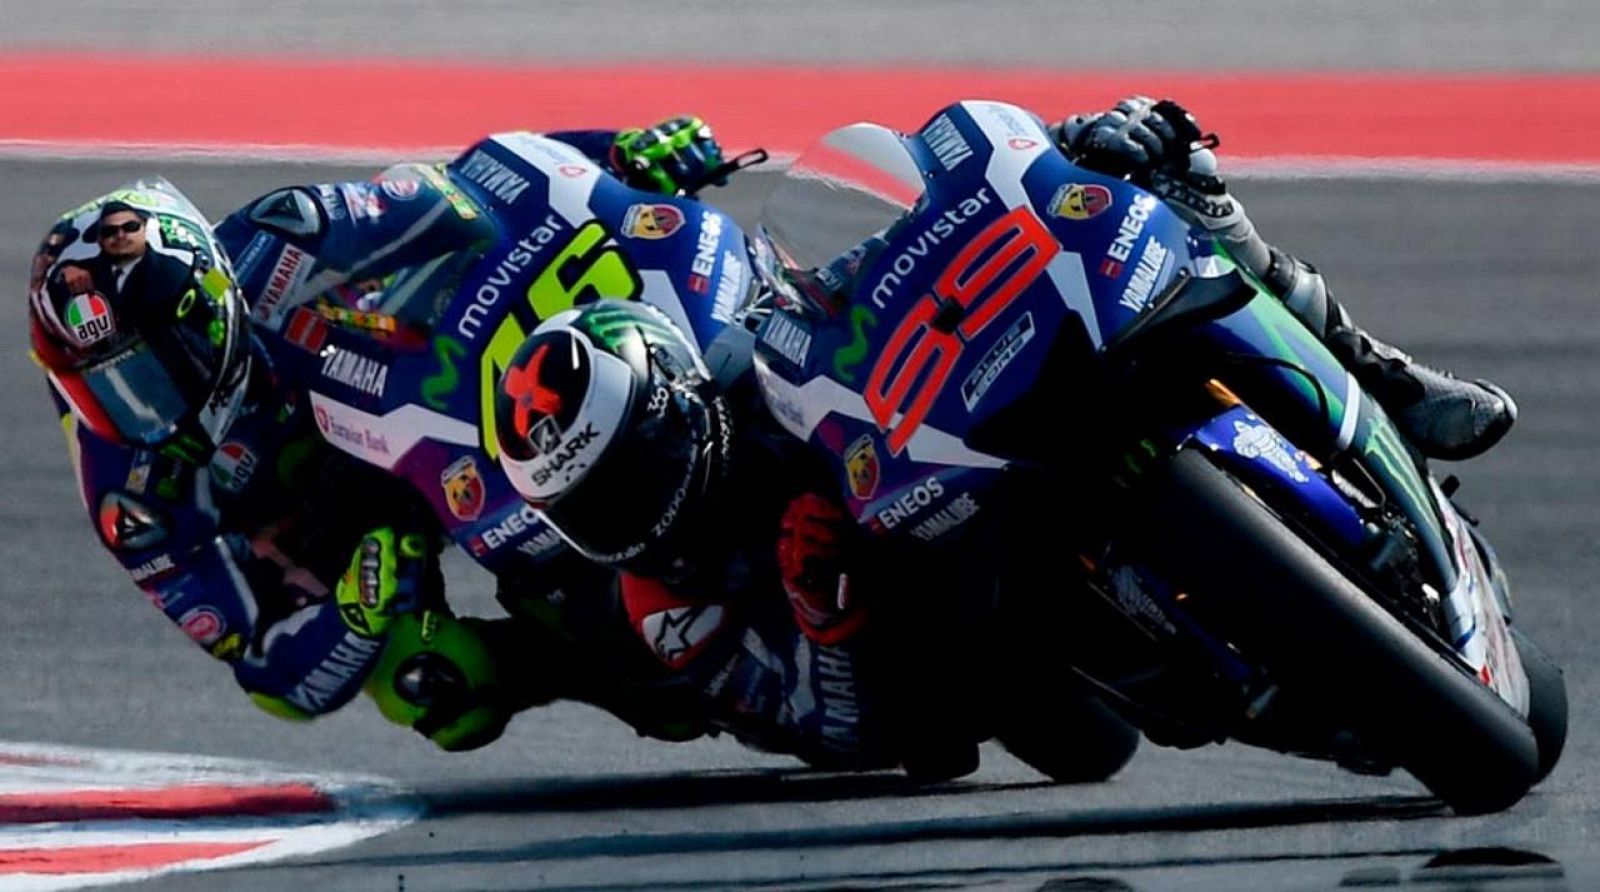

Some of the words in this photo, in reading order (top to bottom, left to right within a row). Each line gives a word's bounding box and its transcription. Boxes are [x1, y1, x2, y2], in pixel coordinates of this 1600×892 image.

[460, 150, 530, 205] YAMAHA
[691, 210, 722, 277] ENEOS
[871, 188, 990, 310] movistar
[1107, 193, 1158, 264] ENEOS
[262, 248, 302, 305] YAMAHA
[457, 213, 564, 340] movistar
[1119, 235, 1168, 313] YAMALUBE
[77, 312, 110, 341] agv
[863, 204, 1064, 459] 99
[320, 347, 389, 398] YAMAHA
[531, 421, 600, 487] SHARK
[482, 505, 540, 549] ENEO
[878, 476, 945, 530] ENEOS
[286, 631, 380, 713] YAMAHA
